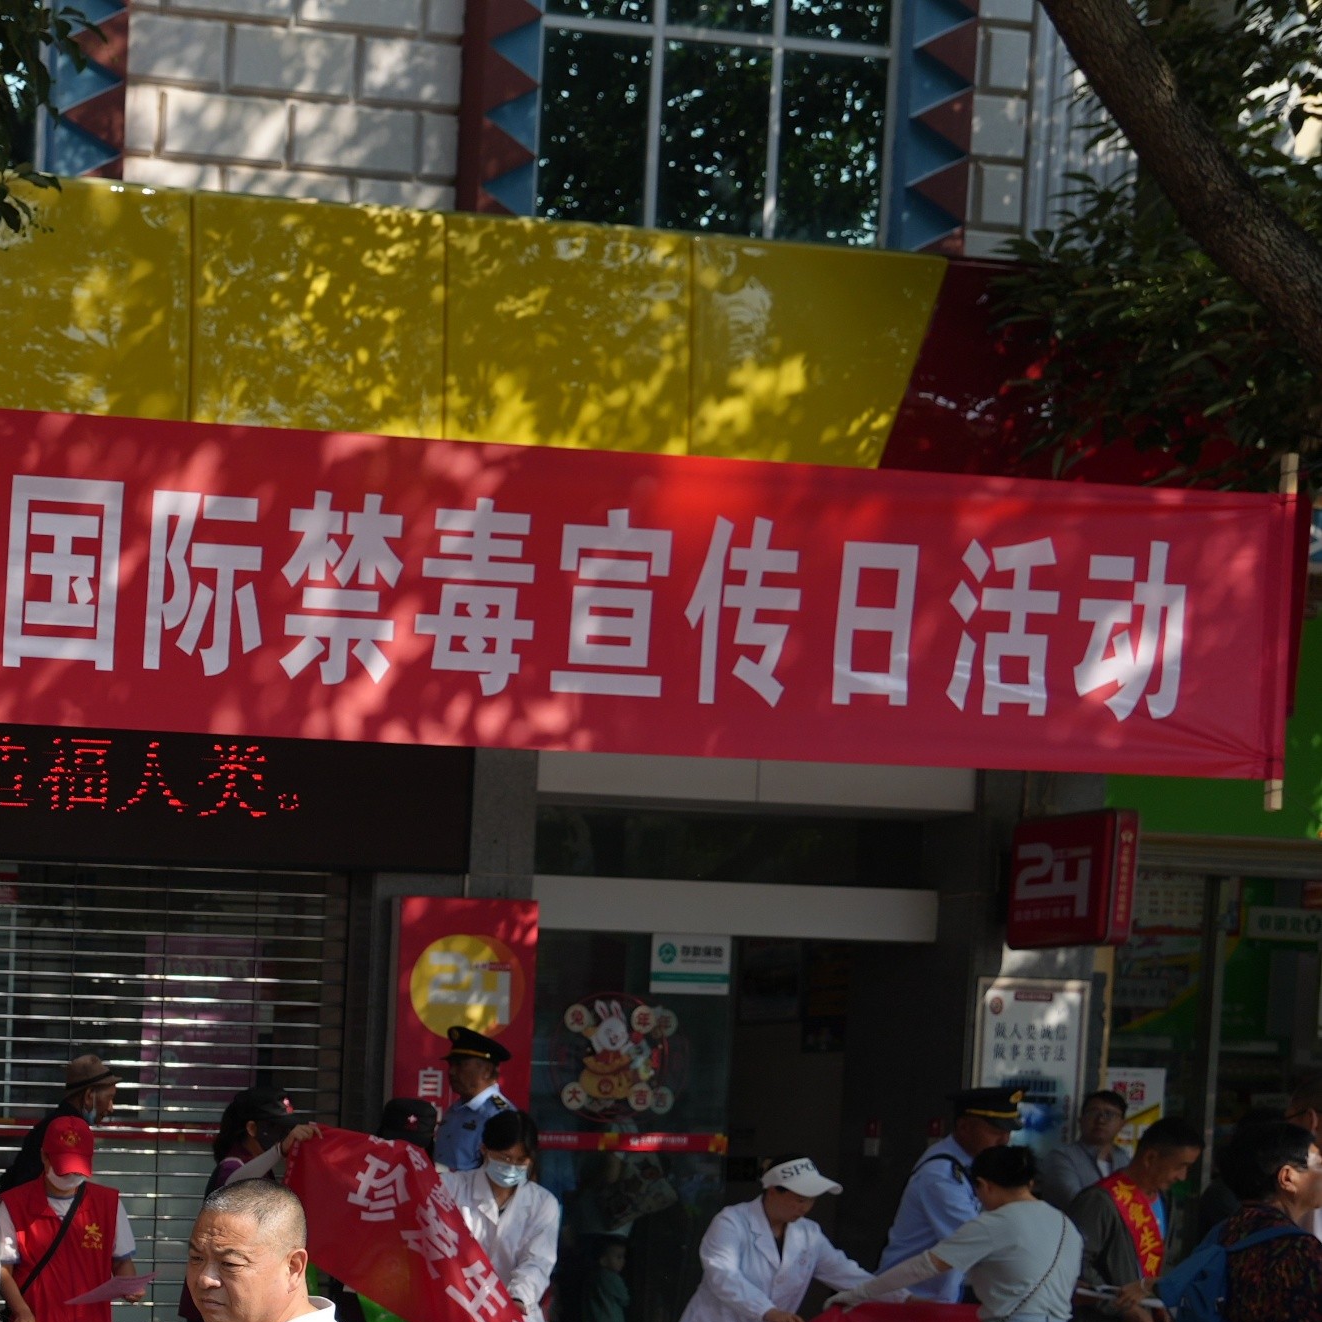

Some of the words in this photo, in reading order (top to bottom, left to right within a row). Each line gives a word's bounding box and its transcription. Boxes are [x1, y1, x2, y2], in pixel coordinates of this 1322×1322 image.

[1015, 842, 1092, 918] 24
[428, 952, 512, 1025] 24
[992, 1042, 1067, 1062] 做事要守法
[994, 1022, 1068, 1041] 做人要诚信
